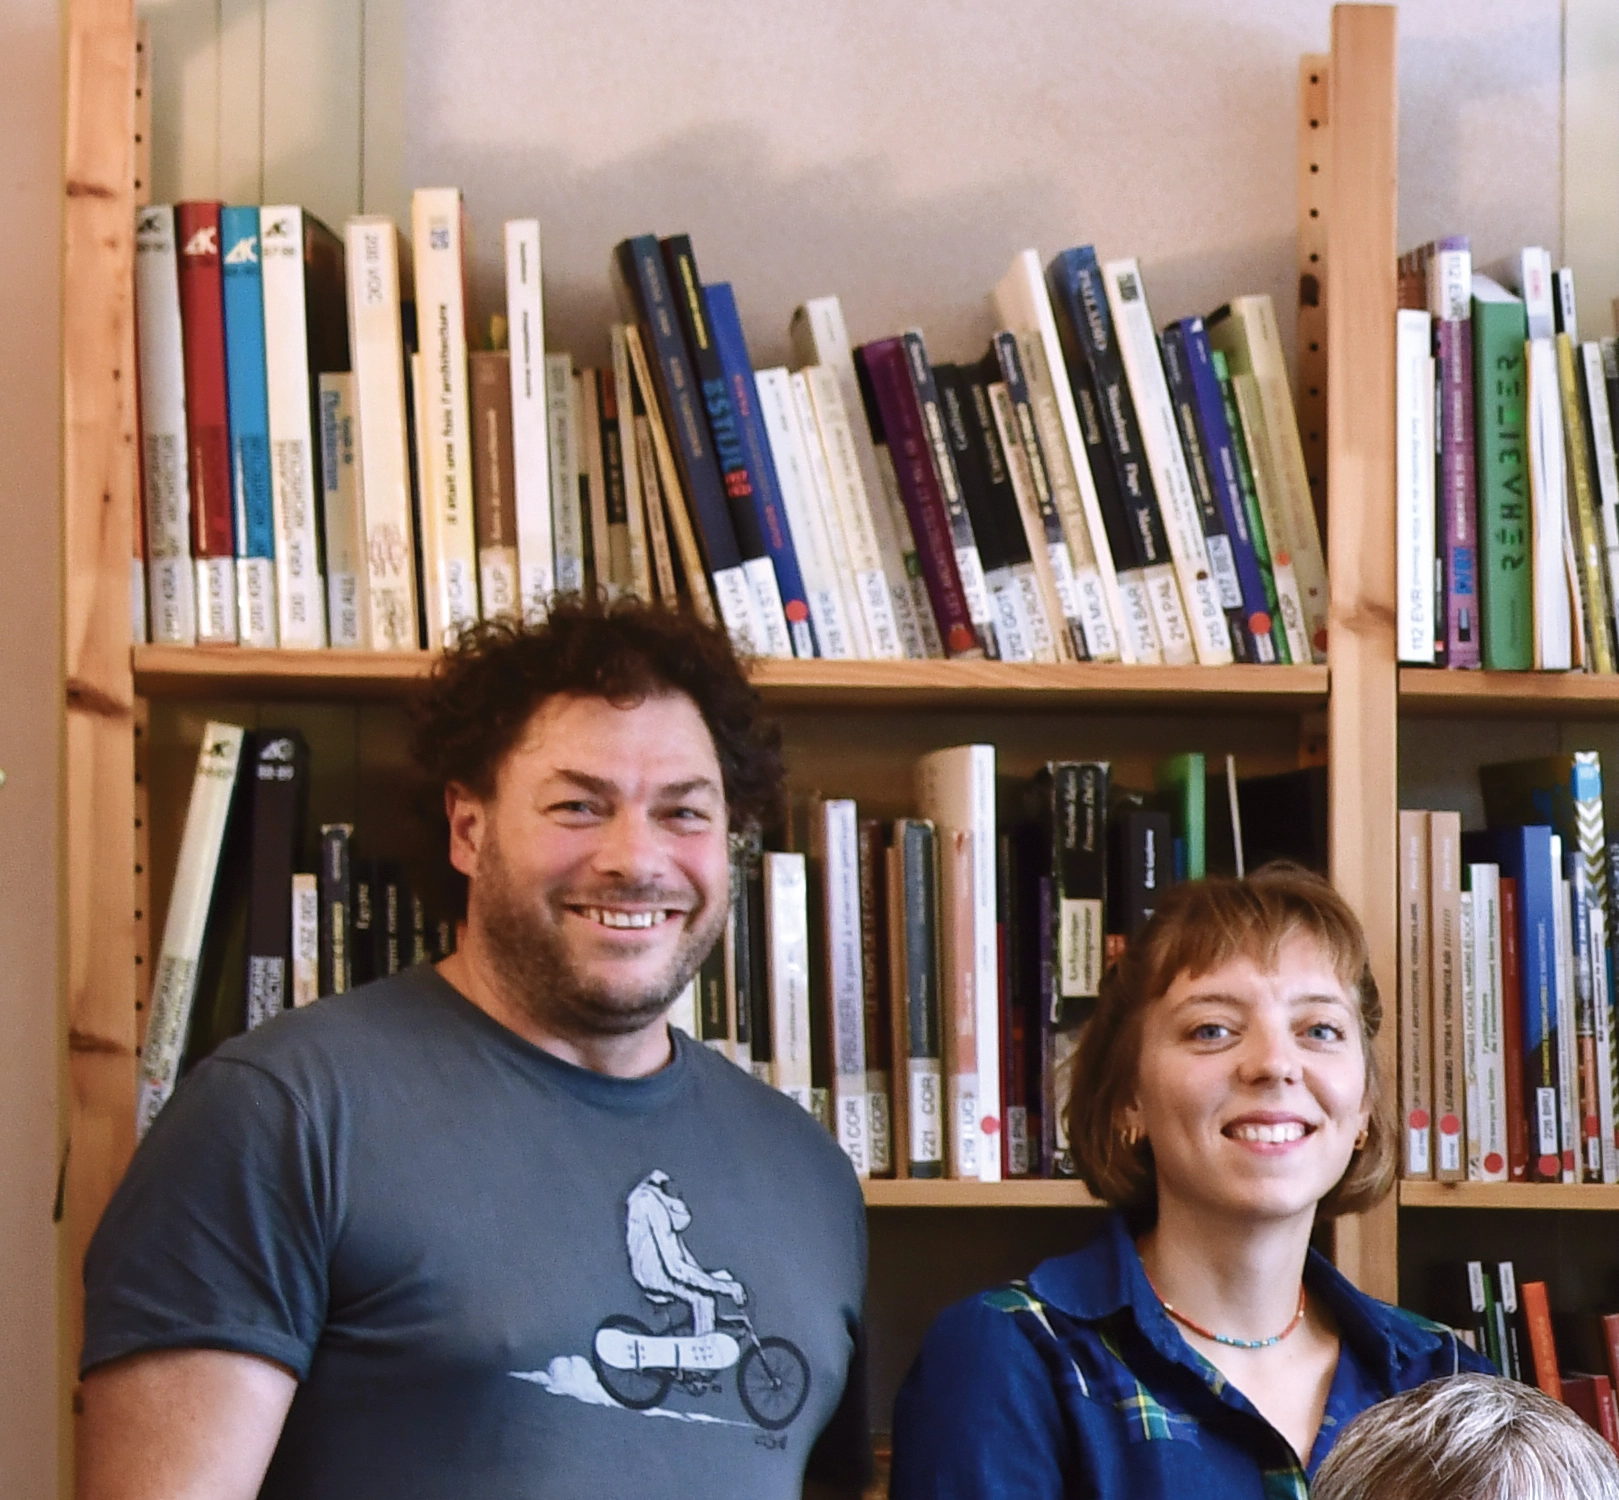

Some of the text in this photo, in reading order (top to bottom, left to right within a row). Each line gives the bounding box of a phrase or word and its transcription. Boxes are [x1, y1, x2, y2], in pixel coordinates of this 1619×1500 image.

[1495, 355, 1525, 570] RÉHABITER
[919, 1075, 935, 1158] 221 COR
